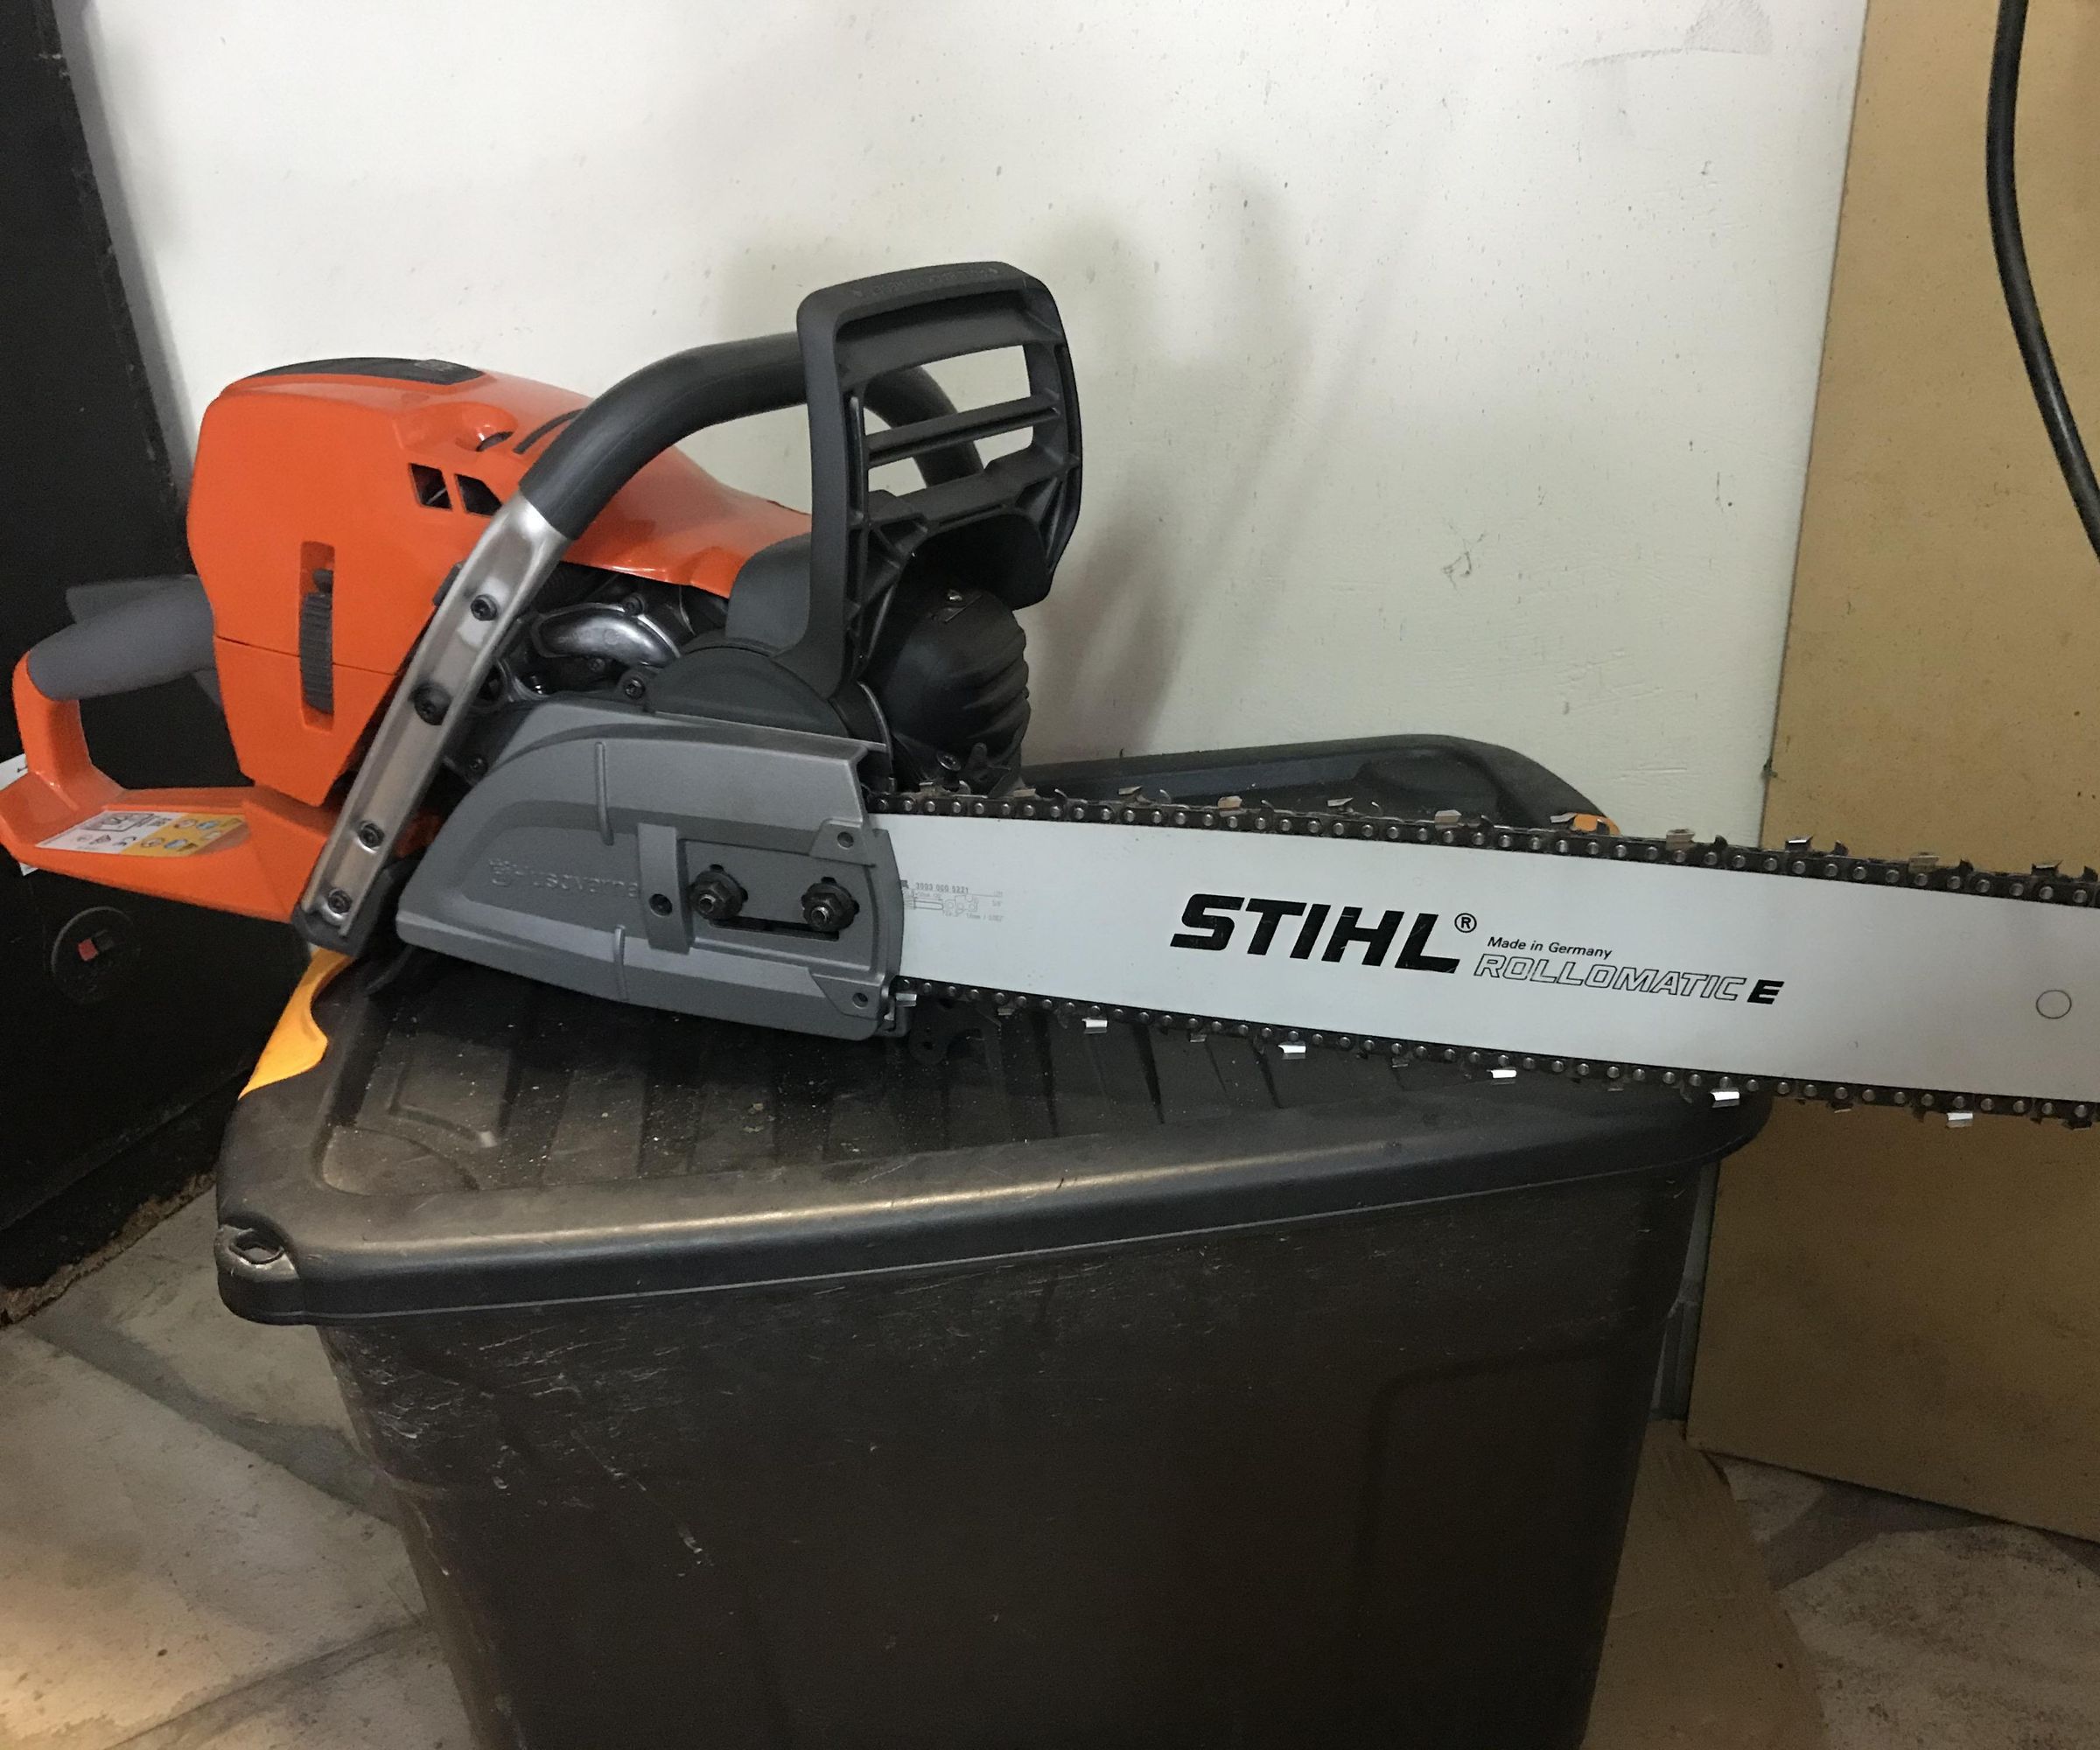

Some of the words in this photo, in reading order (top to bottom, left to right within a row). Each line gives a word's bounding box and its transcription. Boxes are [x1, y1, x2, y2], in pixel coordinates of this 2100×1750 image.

[1170, 893, 1460, 974] STIHL
[1487, 936, 1527, 951] Made
[1531, 940, 1544, 952] in
[1548, 942, 1613, 961] Germany
[1474, 953, 1747, 1001] ROLLOMATIC
[1746, 979, 1784, 1004] E
